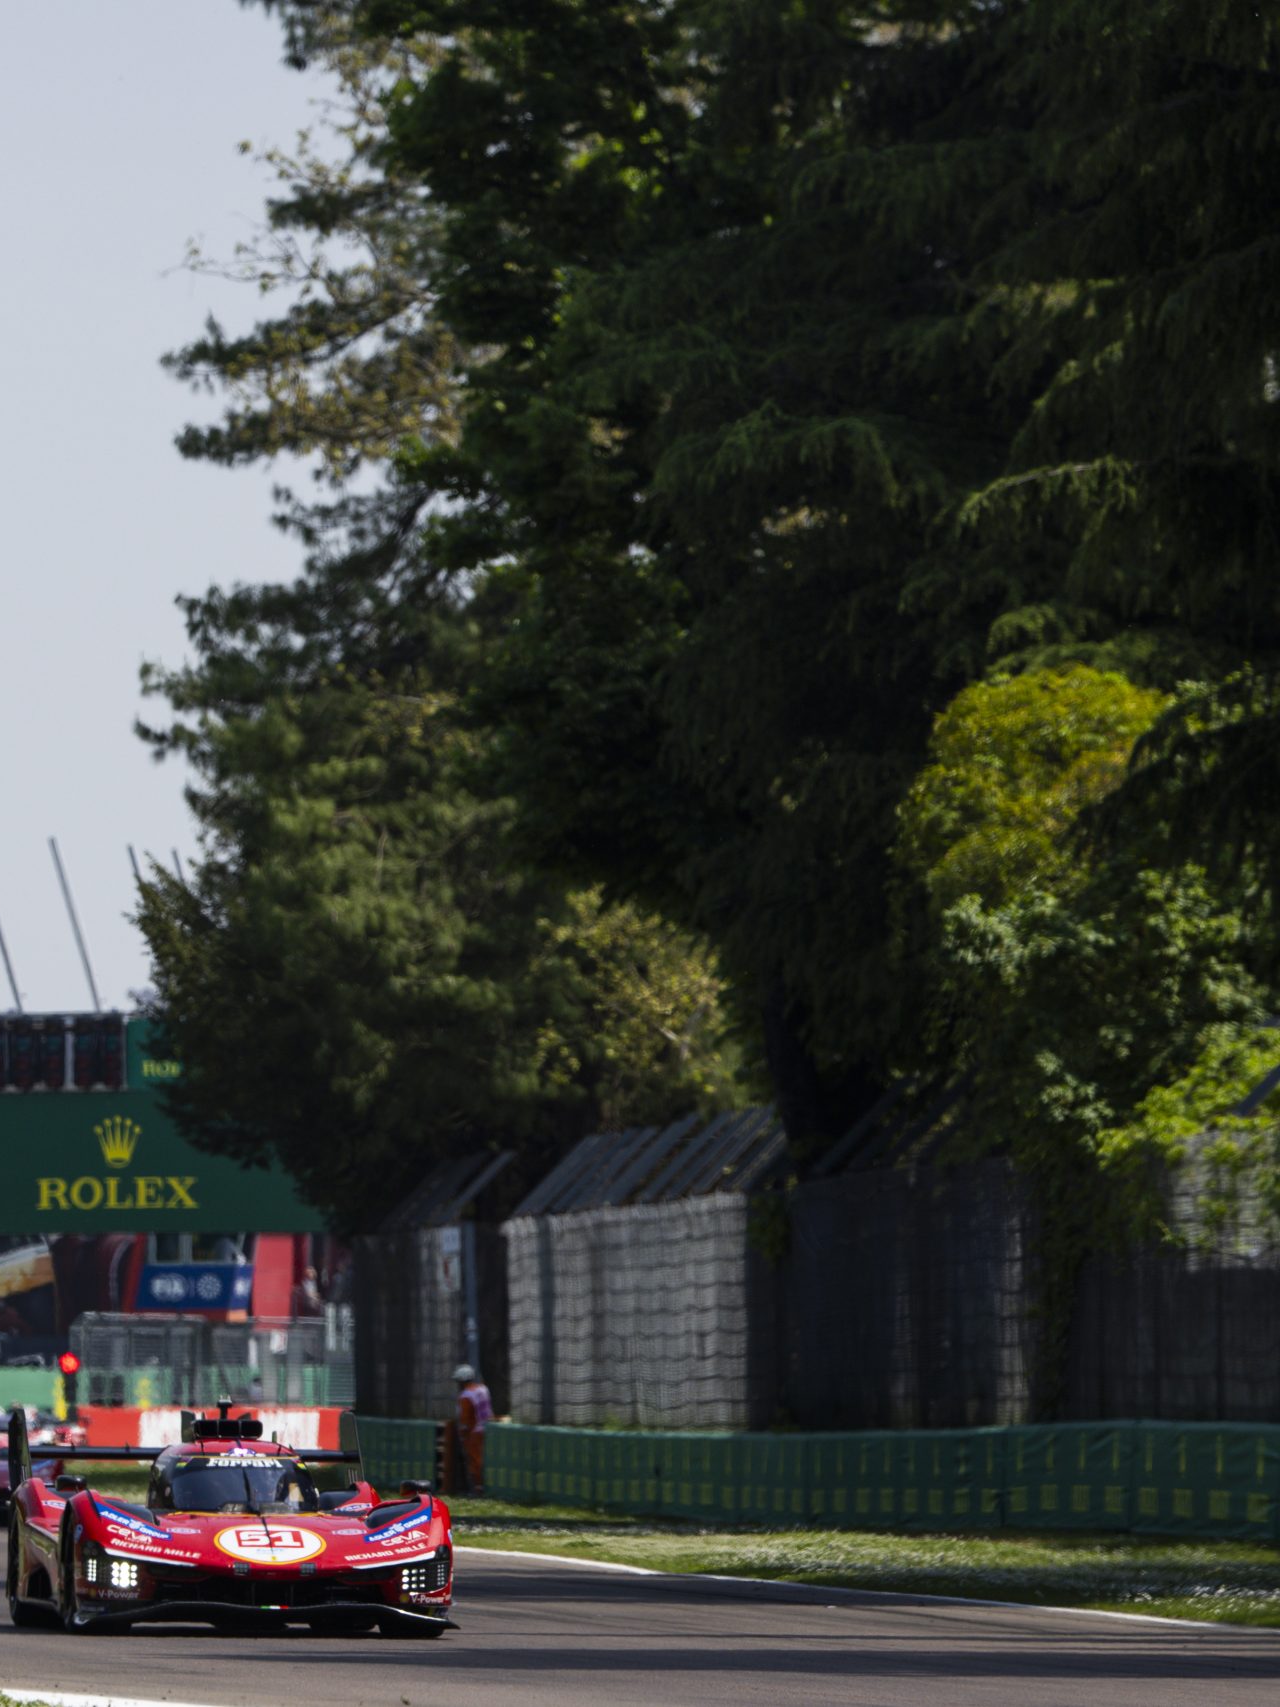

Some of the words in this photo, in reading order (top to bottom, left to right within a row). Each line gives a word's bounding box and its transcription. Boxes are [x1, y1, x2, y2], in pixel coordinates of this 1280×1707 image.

[36, 1176, 200, 1211] ROLEX
[206, 1458, 283, 1468] Ferrari
[239, 1530, 302, 1547] 51
[110, 1538, 162, 1553] RICHARD
[163, 1548, 202, 1559] MILLE
[344, 1550, 394, 1561] RICHARD
[395, 1542, 426, 1554] MILLE
[98, 1589, 140, 1599] V-Power
[411, 1593, 445, 1604] V-Power
